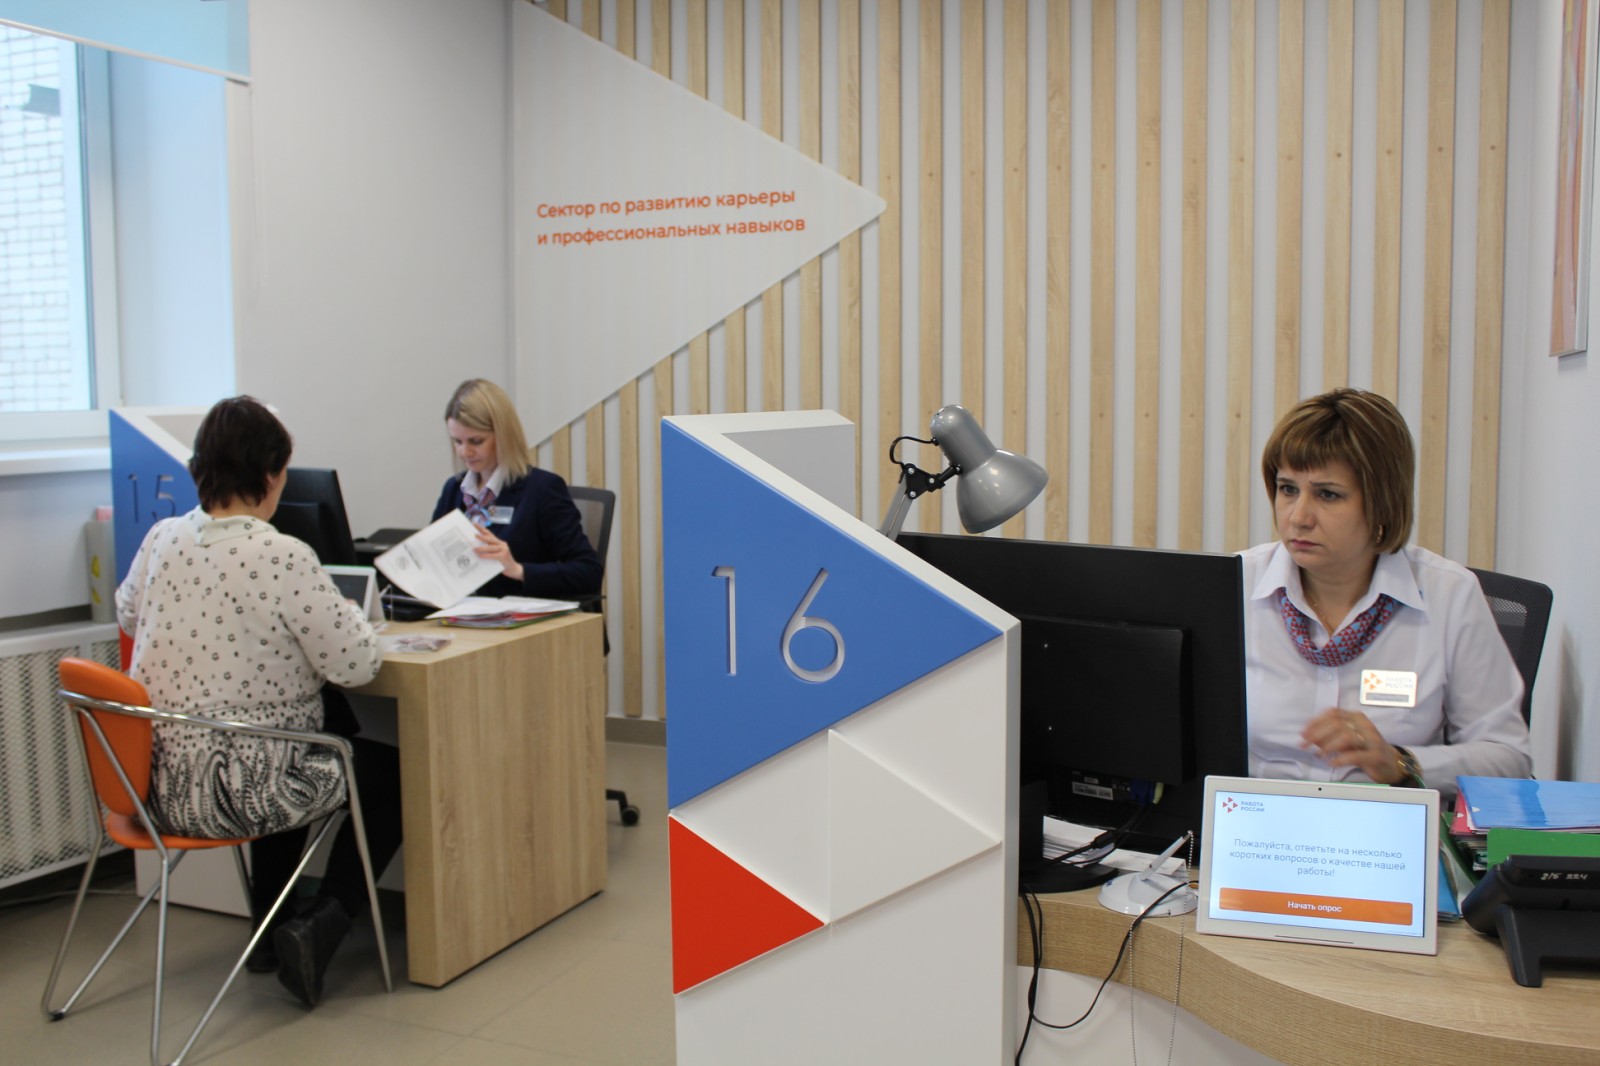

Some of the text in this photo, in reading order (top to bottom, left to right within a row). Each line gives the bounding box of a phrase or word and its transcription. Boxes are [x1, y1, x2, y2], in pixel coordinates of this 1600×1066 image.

[537, 191, 795, 218] Сектор по развитию карьеры
[537, 219, 806, 247] и профессиональных навыков
[128, 474, 176, 523] 15
[711, 565, 845, 683] 16
[1234, 838, 1402, 859] Пожалуйста, ответьте на несколько
[1229, 851, 1272, 860] коротких
[1274, 854, 1319, 864] вопросов
[1328, 858, 1372, 868] качестве
[1374, 862, 1406, 871] нашей
[1297, 866, 1335, 877] работы!
[1287, 900, 1342, 912] Начать опрос
